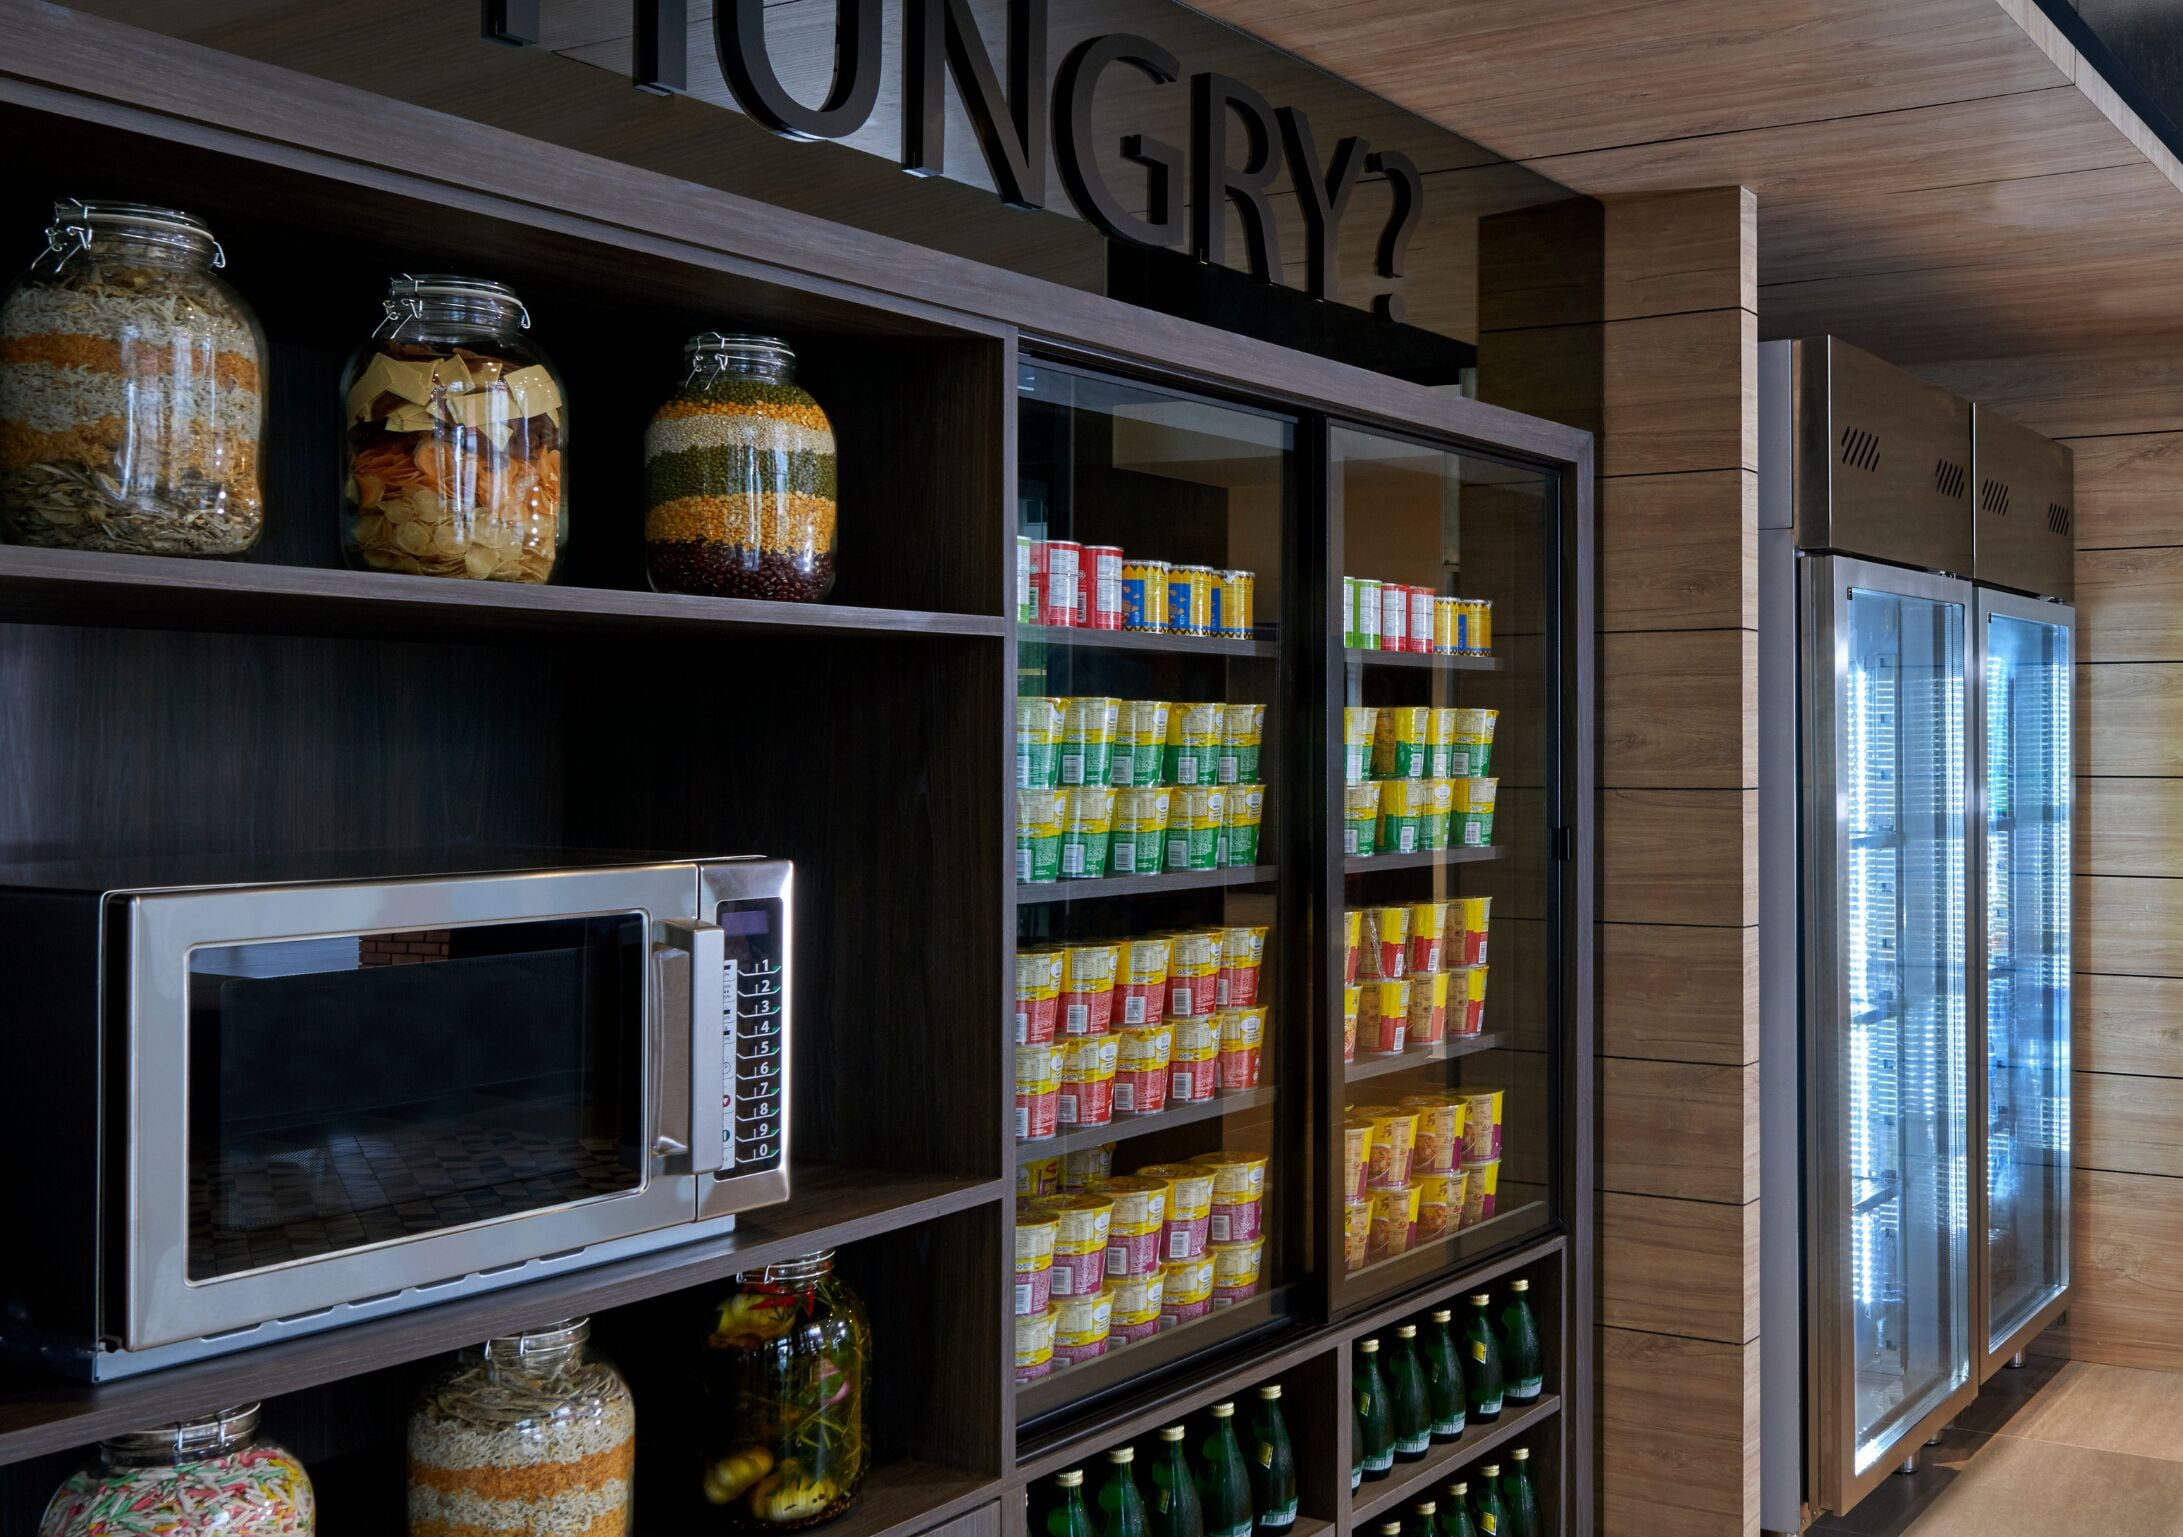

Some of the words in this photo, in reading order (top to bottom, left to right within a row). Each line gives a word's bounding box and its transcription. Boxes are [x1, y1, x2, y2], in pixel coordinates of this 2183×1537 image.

[762, 959, 770, 972] 1
[761, 979, 770, 992] 2
[761, 1000, 770, 1013] 3
[761, 1020, 770, 1033] 4
[761, 1041, 769, 1054] 5
[760, 1062, 769, 1075] 6
[760, 1082, 769, 1095] 7
[760, 1103, 769, 1116] 8
[759, 1123, 768, 1136] 9
[759, 1144, 768, 1157] 0
